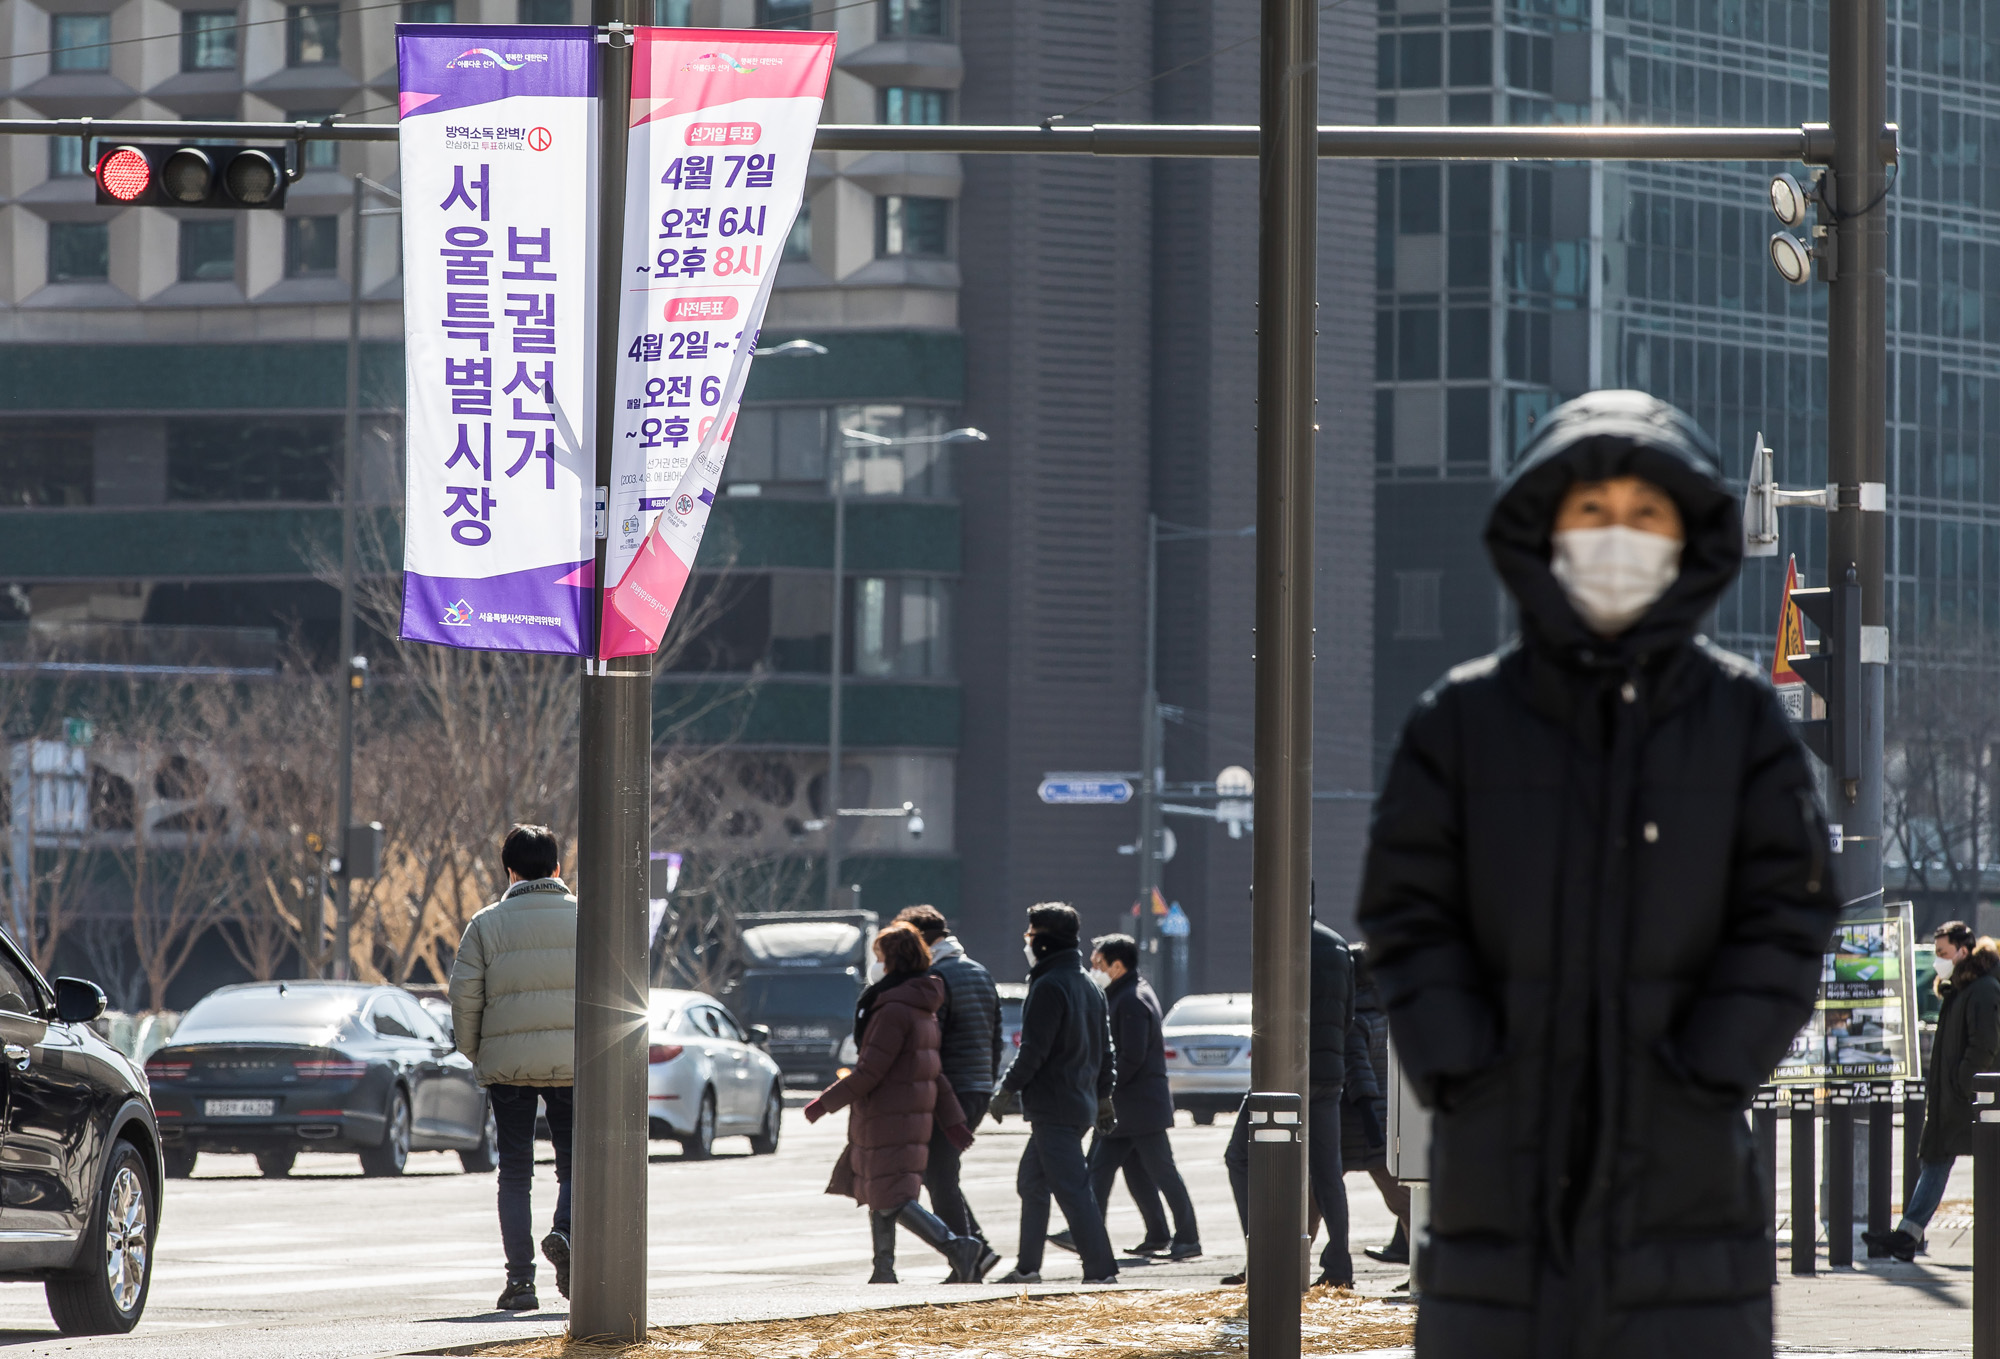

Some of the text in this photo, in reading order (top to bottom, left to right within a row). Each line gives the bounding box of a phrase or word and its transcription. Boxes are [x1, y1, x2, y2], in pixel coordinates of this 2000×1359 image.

[457, 60, 495, 68] 아름다운 선거
[524, 54, 548, 62] 대한민국
[760, 58, 783, 66] 대한민국
[693, 64, 730, 72] 아름다운 선거
[446, 126, 526, 140] 방역소독 완벽!
[691, 126, 754, 141] 선거일 투표
[445, 140, 479, 150] 안심하고
[661, 154, 776, 190] 4월 7일
[659, 205, 767, 239] 오전 6시
[713, 245, 762, 277] 8시
[675, 301, 724, 317] 사전투표
[628, 333, 663, 362] 4월
[668, 331, 709, 359] 2일
[440, 163, 497, 547] 서울특별시장
[502, 226, 557, 490] 보궐선거
[643, 376, 692, 408] 오전
[700, 376, 721, 406] 6
[647, 458, 671, 469] 선거권
[478, 612, 561, 627] 서울특별시선거관리위원회
[1777, 1067, 1804, 1077] HEALTH
[1813, 1065, 1834, 1075] YOGA
